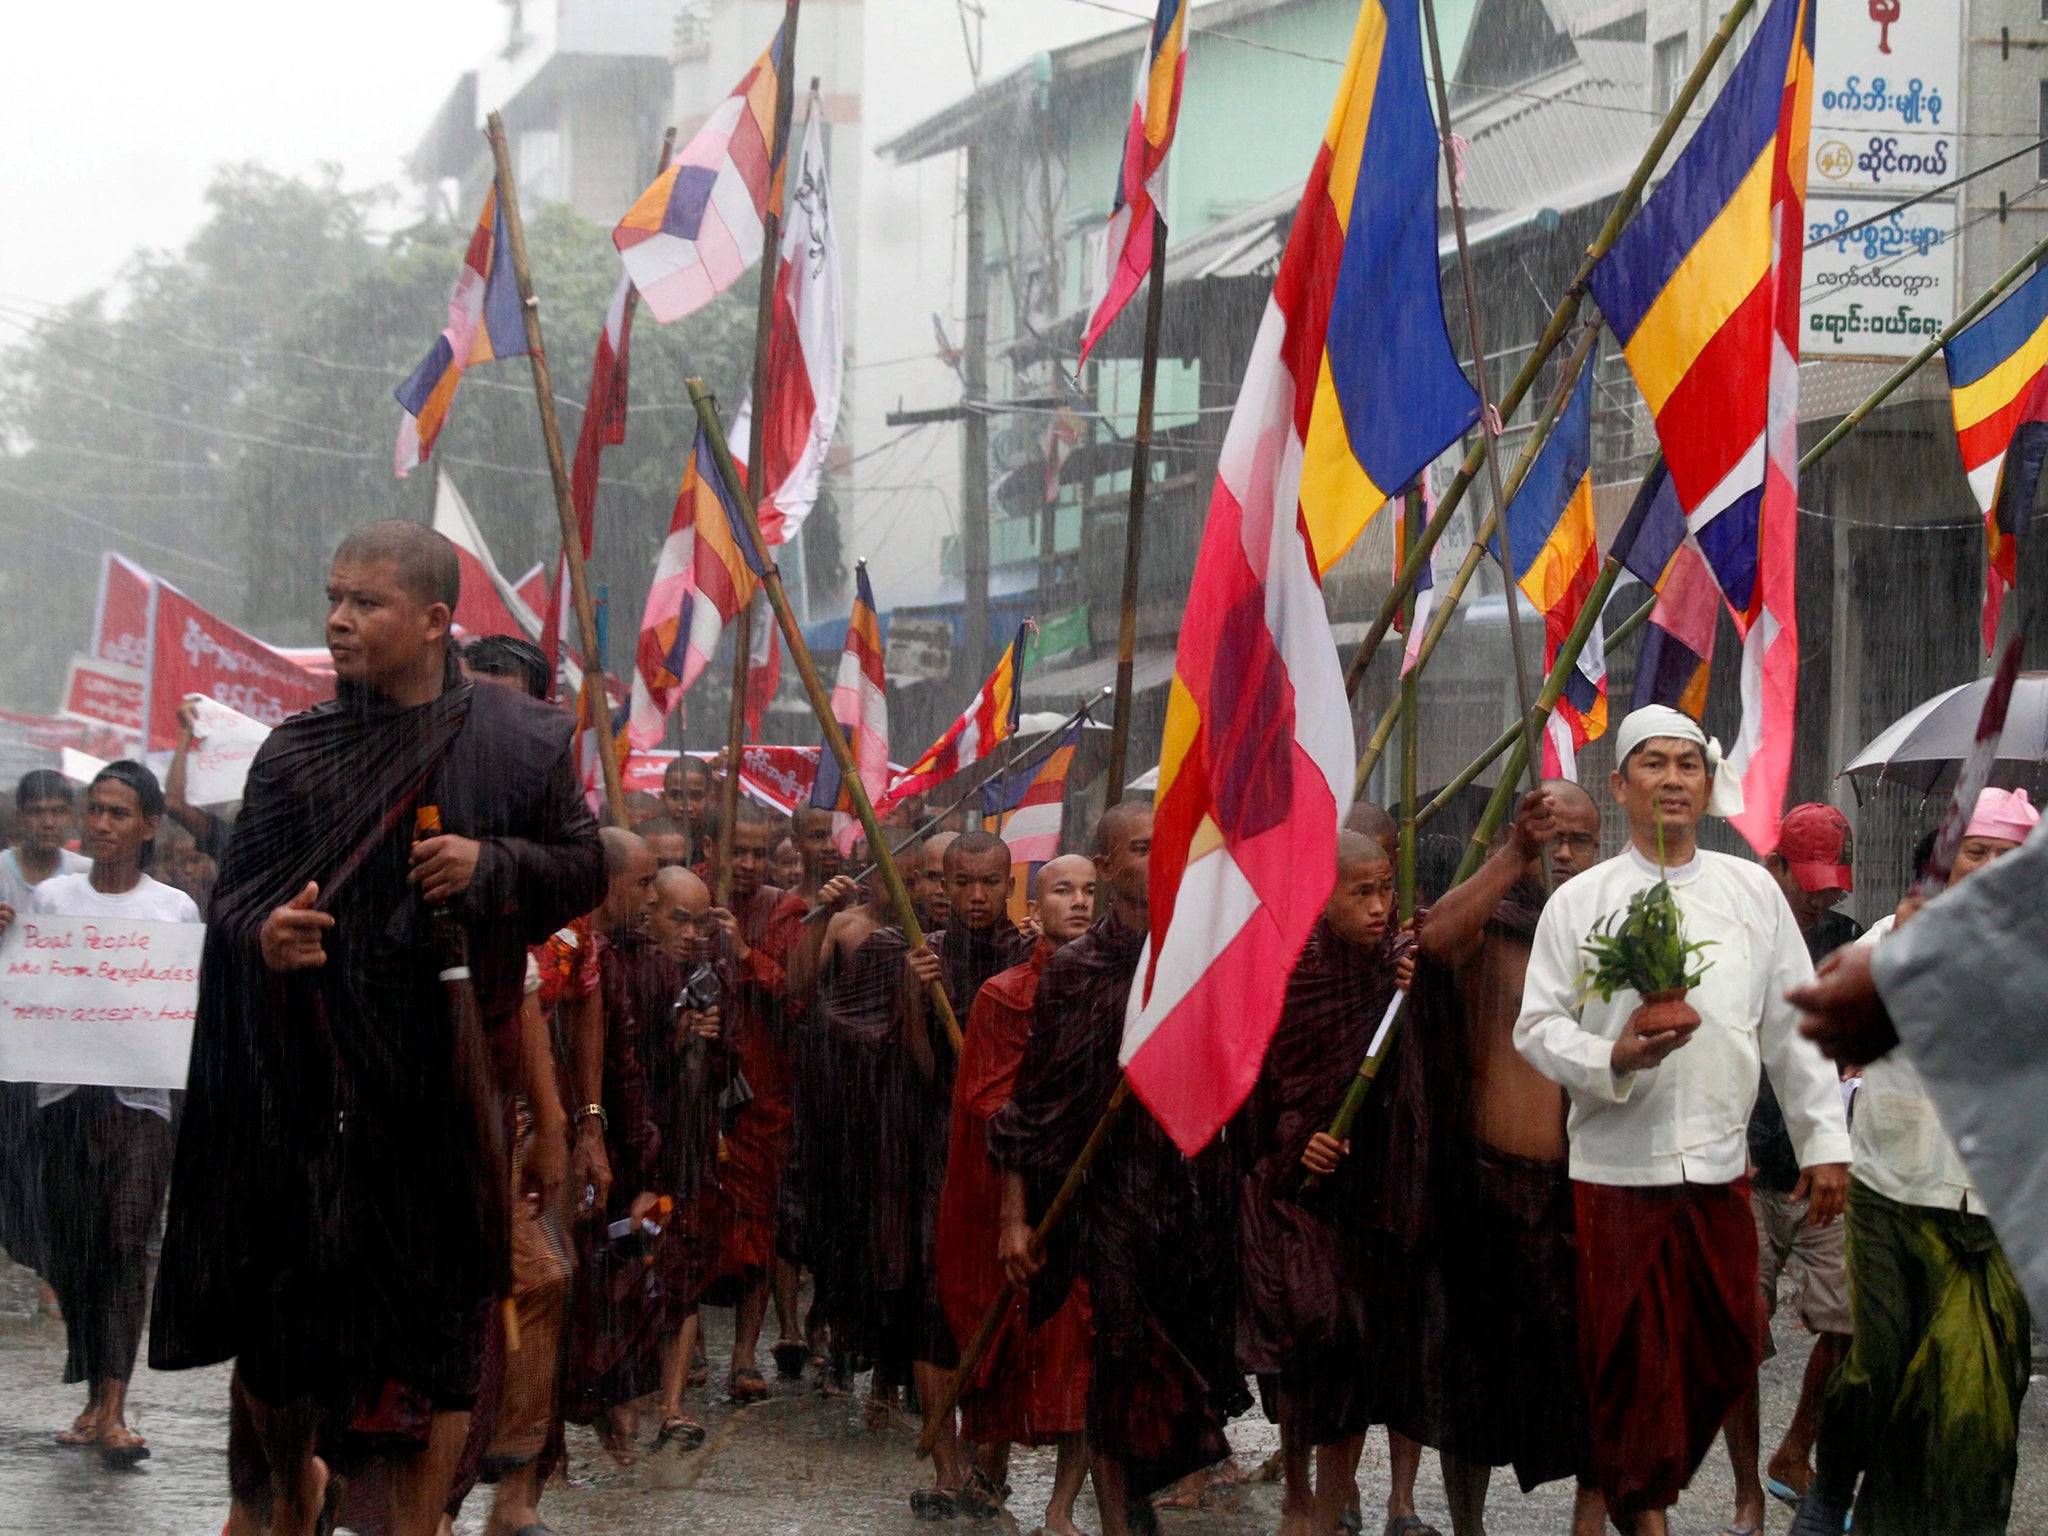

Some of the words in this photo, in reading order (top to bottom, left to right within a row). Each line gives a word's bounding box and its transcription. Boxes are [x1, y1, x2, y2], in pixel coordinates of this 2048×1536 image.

[1858, 137, 1948, 182] ဆိုင်ကယ်
[23, 924, 73, 949] Boat
[83, 924, 150, 953] People
